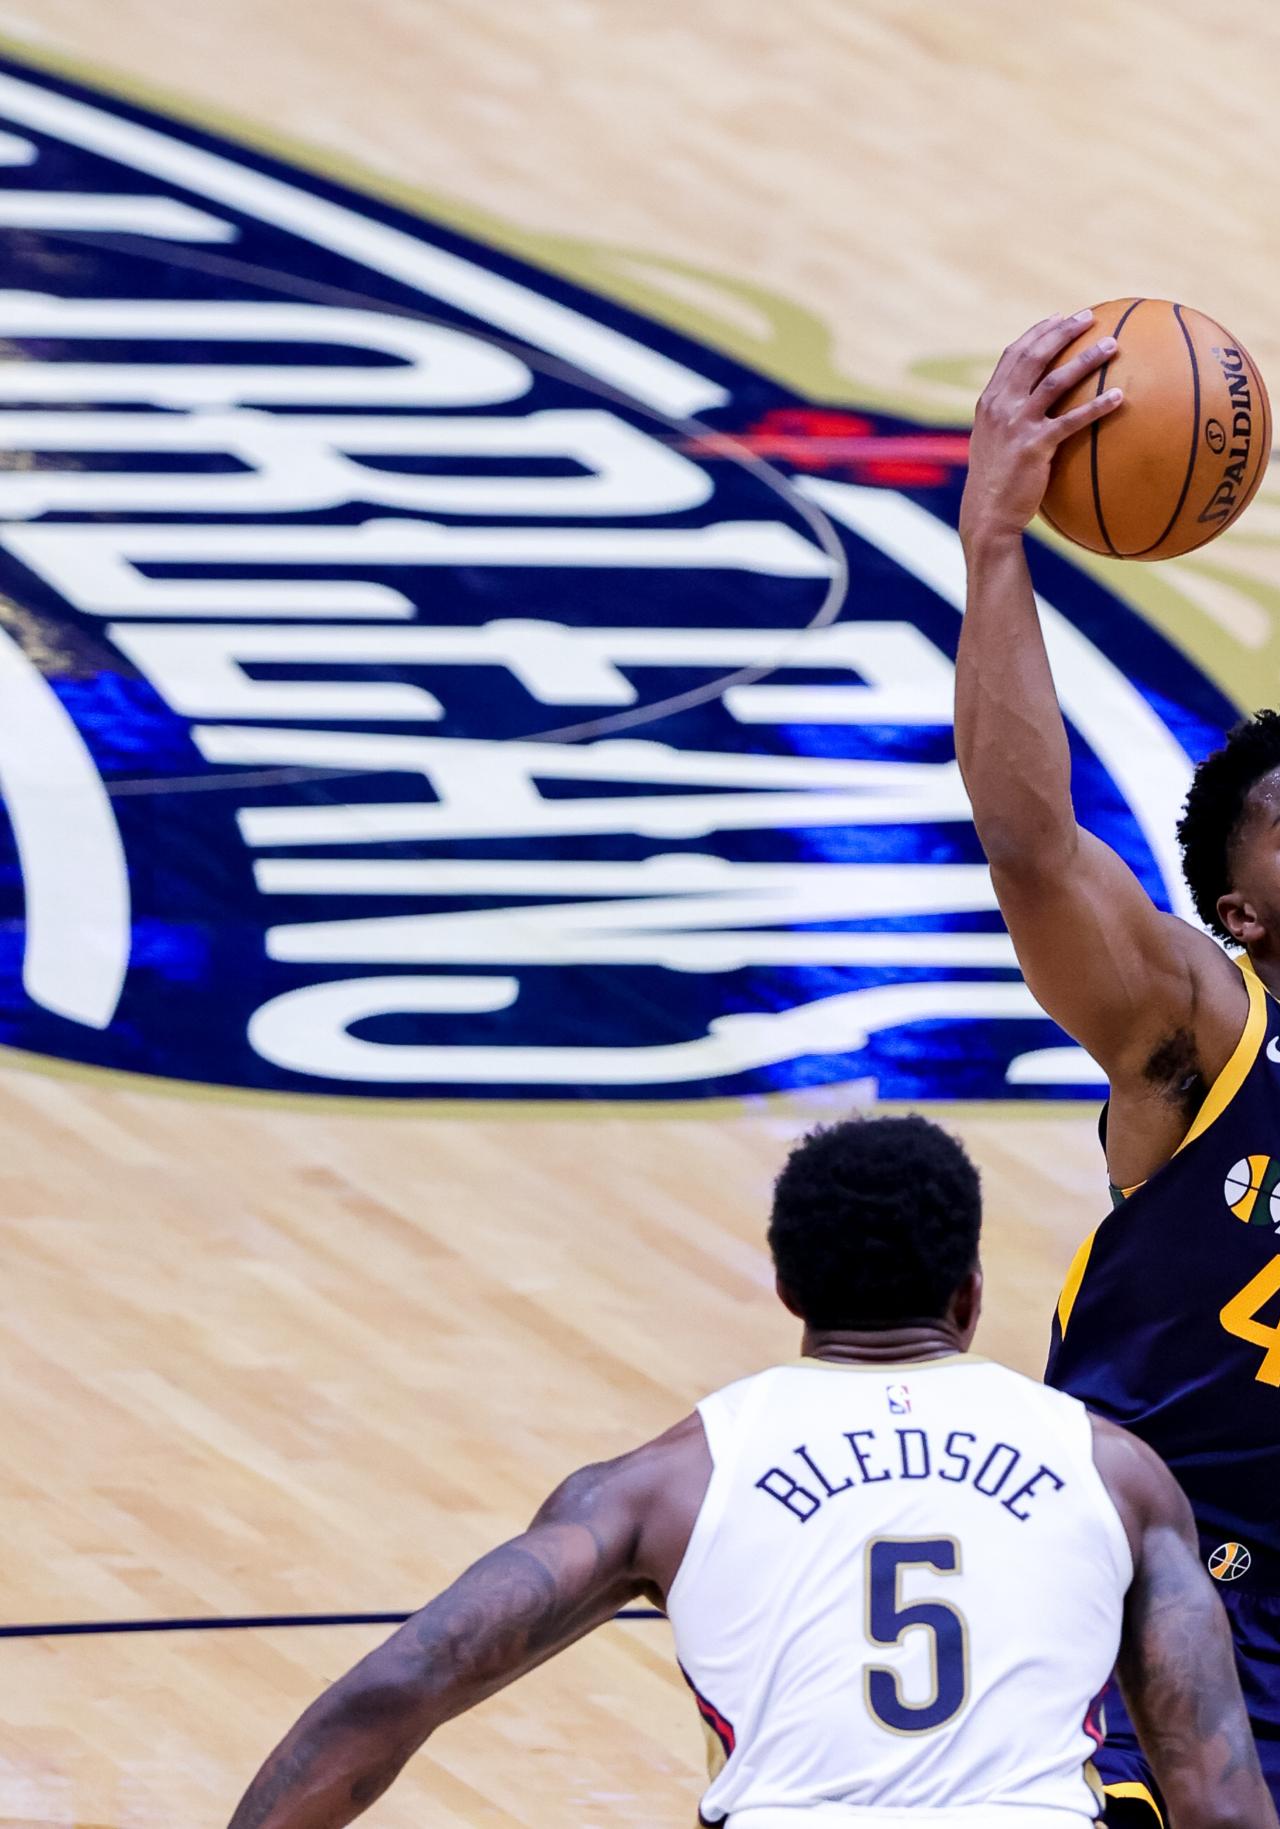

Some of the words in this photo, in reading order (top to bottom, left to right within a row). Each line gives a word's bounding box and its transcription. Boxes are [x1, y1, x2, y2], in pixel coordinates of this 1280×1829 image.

[1197, 347, 1251, 524] SPALDING
[755, 1428, 1066, 1523] BLEDSOE
[863, 1534, 971, 1738] 5
